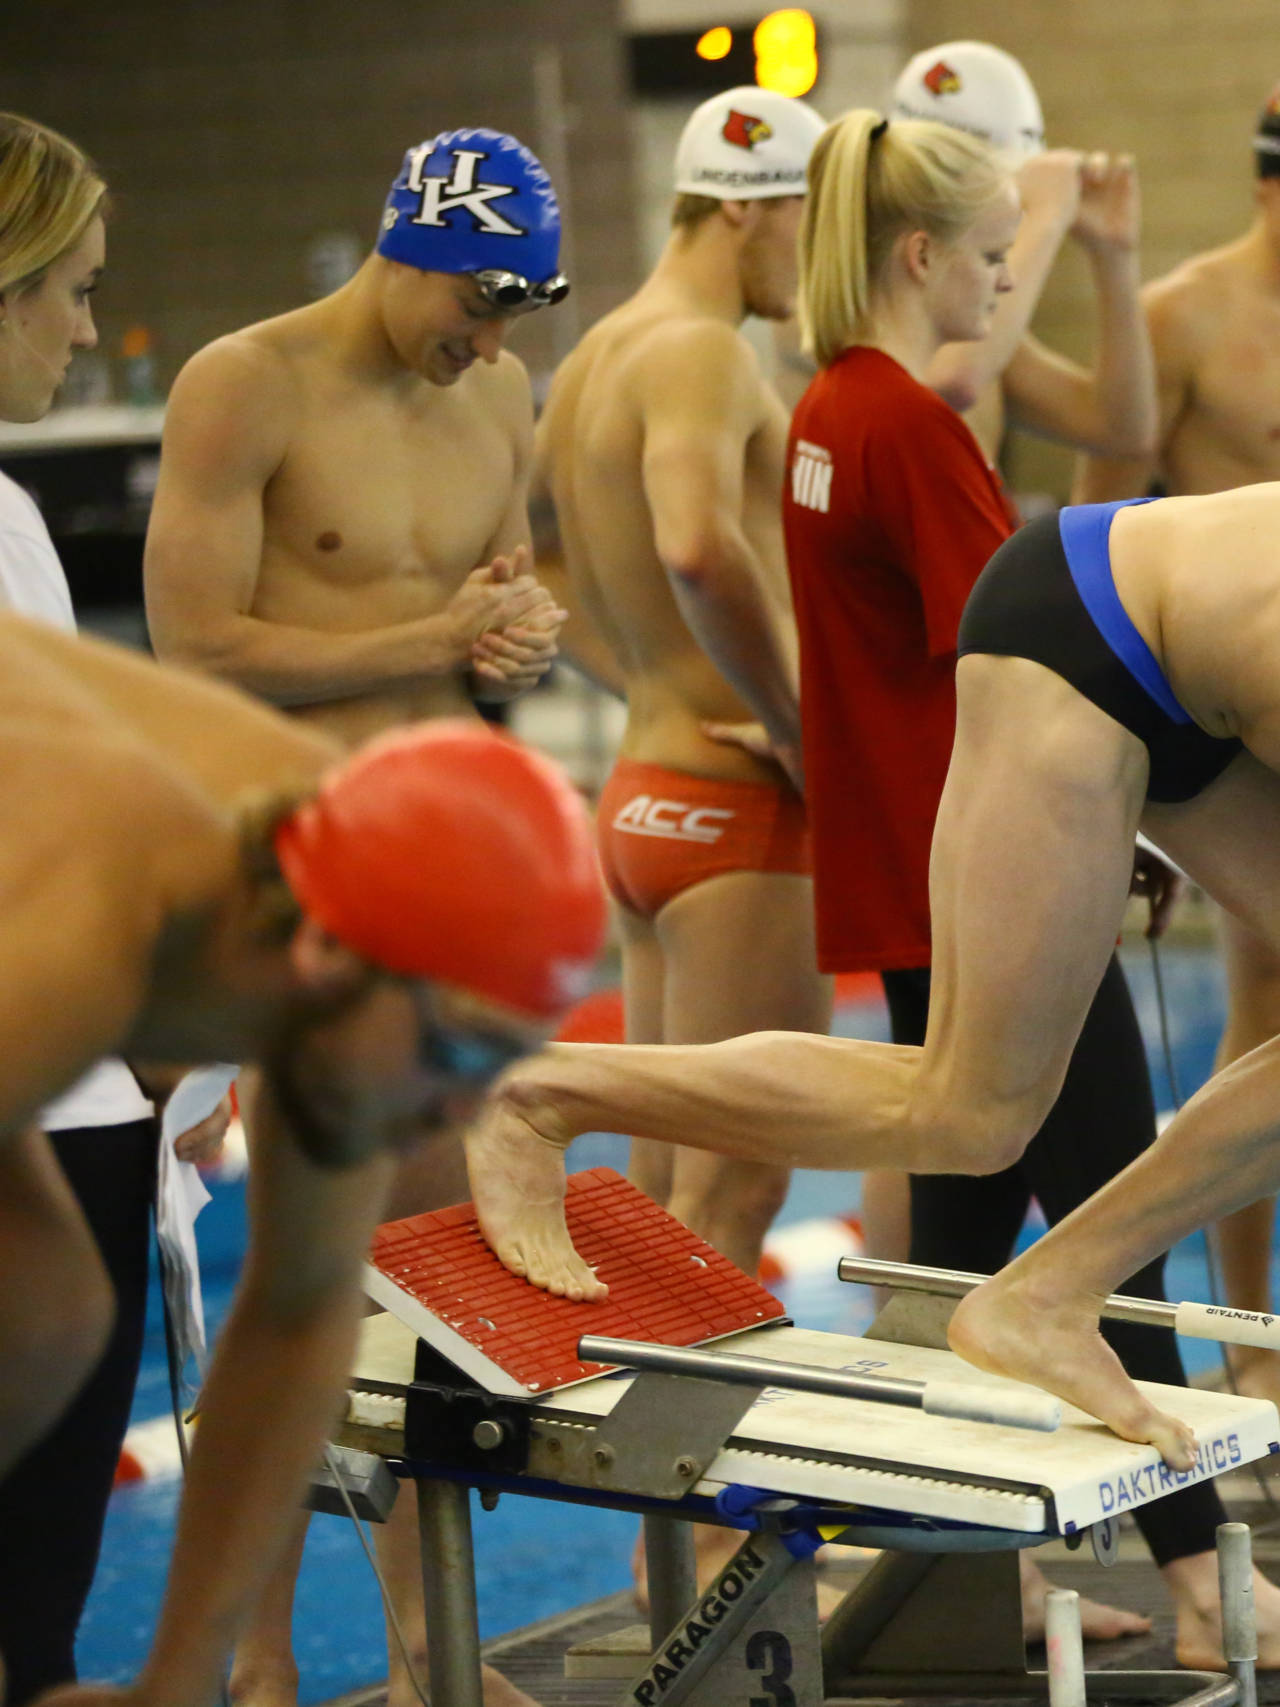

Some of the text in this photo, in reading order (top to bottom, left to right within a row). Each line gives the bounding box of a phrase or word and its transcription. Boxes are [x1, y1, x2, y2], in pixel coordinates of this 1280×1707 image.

[406, 146, 524, 236] UK
[612, 795, 736, 843] ACC
[1206, 1307, 1259, 1322] PENTAIR
[634, 1545, 766, 1707] PARAGON
[746, 1630, 797, 1707] 3
